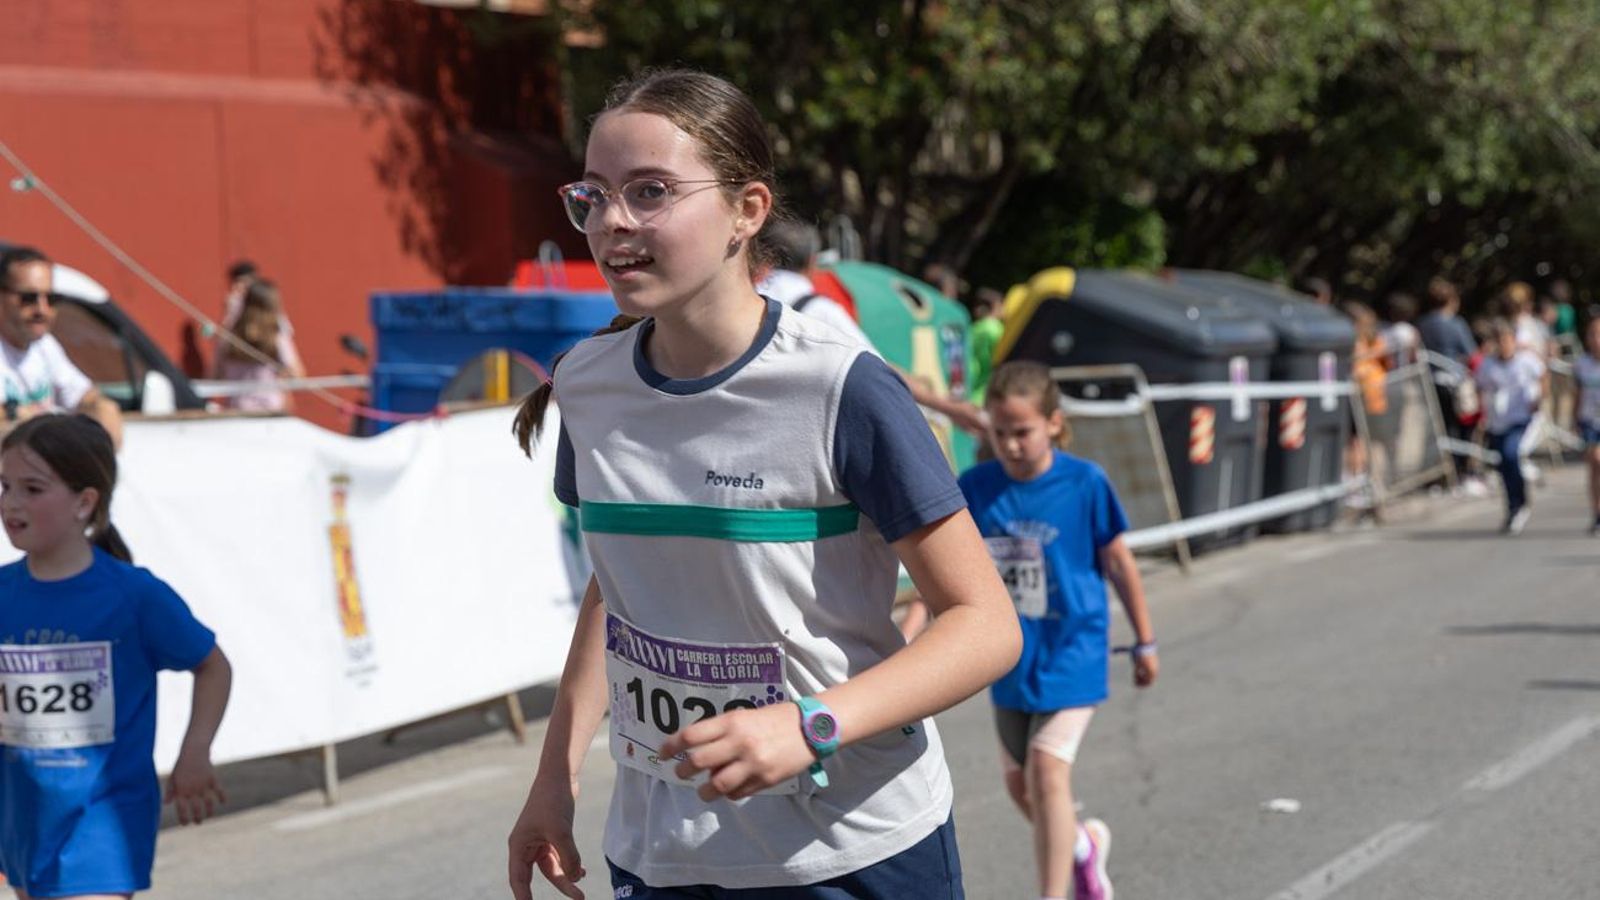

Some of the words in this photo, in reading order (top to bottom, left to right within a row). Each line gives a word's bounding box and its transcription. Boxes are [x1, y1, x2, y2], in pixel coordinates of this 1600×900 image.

[704, 470, 764, 489] Poveda
[677, 649, 722, 666] CARRERA
[725, 652, 774, 666] ESCOLAR
[686, 665, 701, 679] LA
[711, 665, 761, 680] GLORIA
[0, 683, 94, 714] 1628
[627, 677, 757, 735] 102
